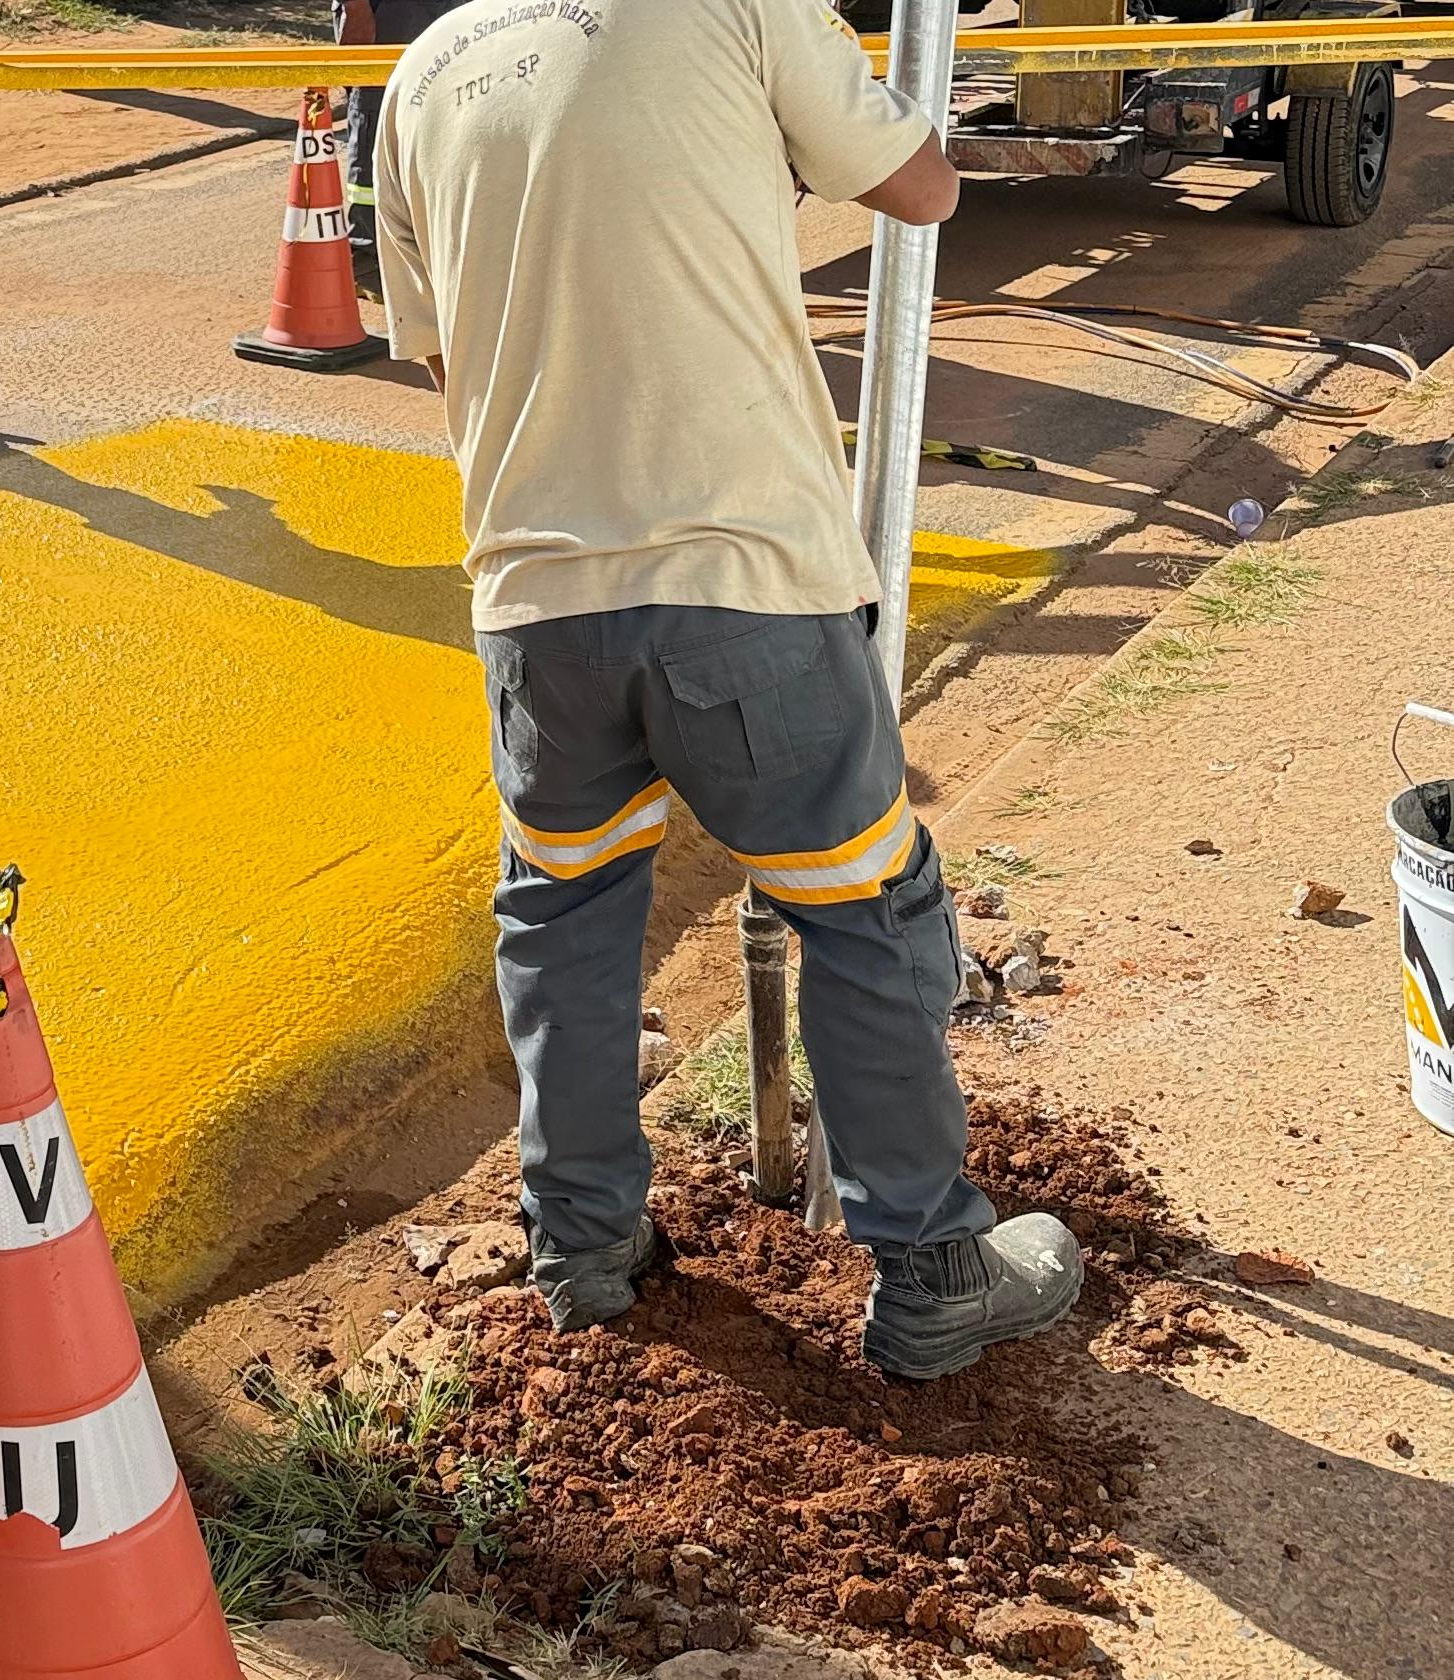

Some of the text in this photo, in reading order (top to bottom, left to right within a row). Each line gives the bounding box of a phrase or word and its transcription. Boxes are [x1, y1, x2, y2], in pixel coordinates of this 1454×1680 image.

[410, 50, 451, 108] Divisão
[453, 35, 469, 55] de
[456, 73, 493, 106] ITU
[517, 54, 540, 79] SP
